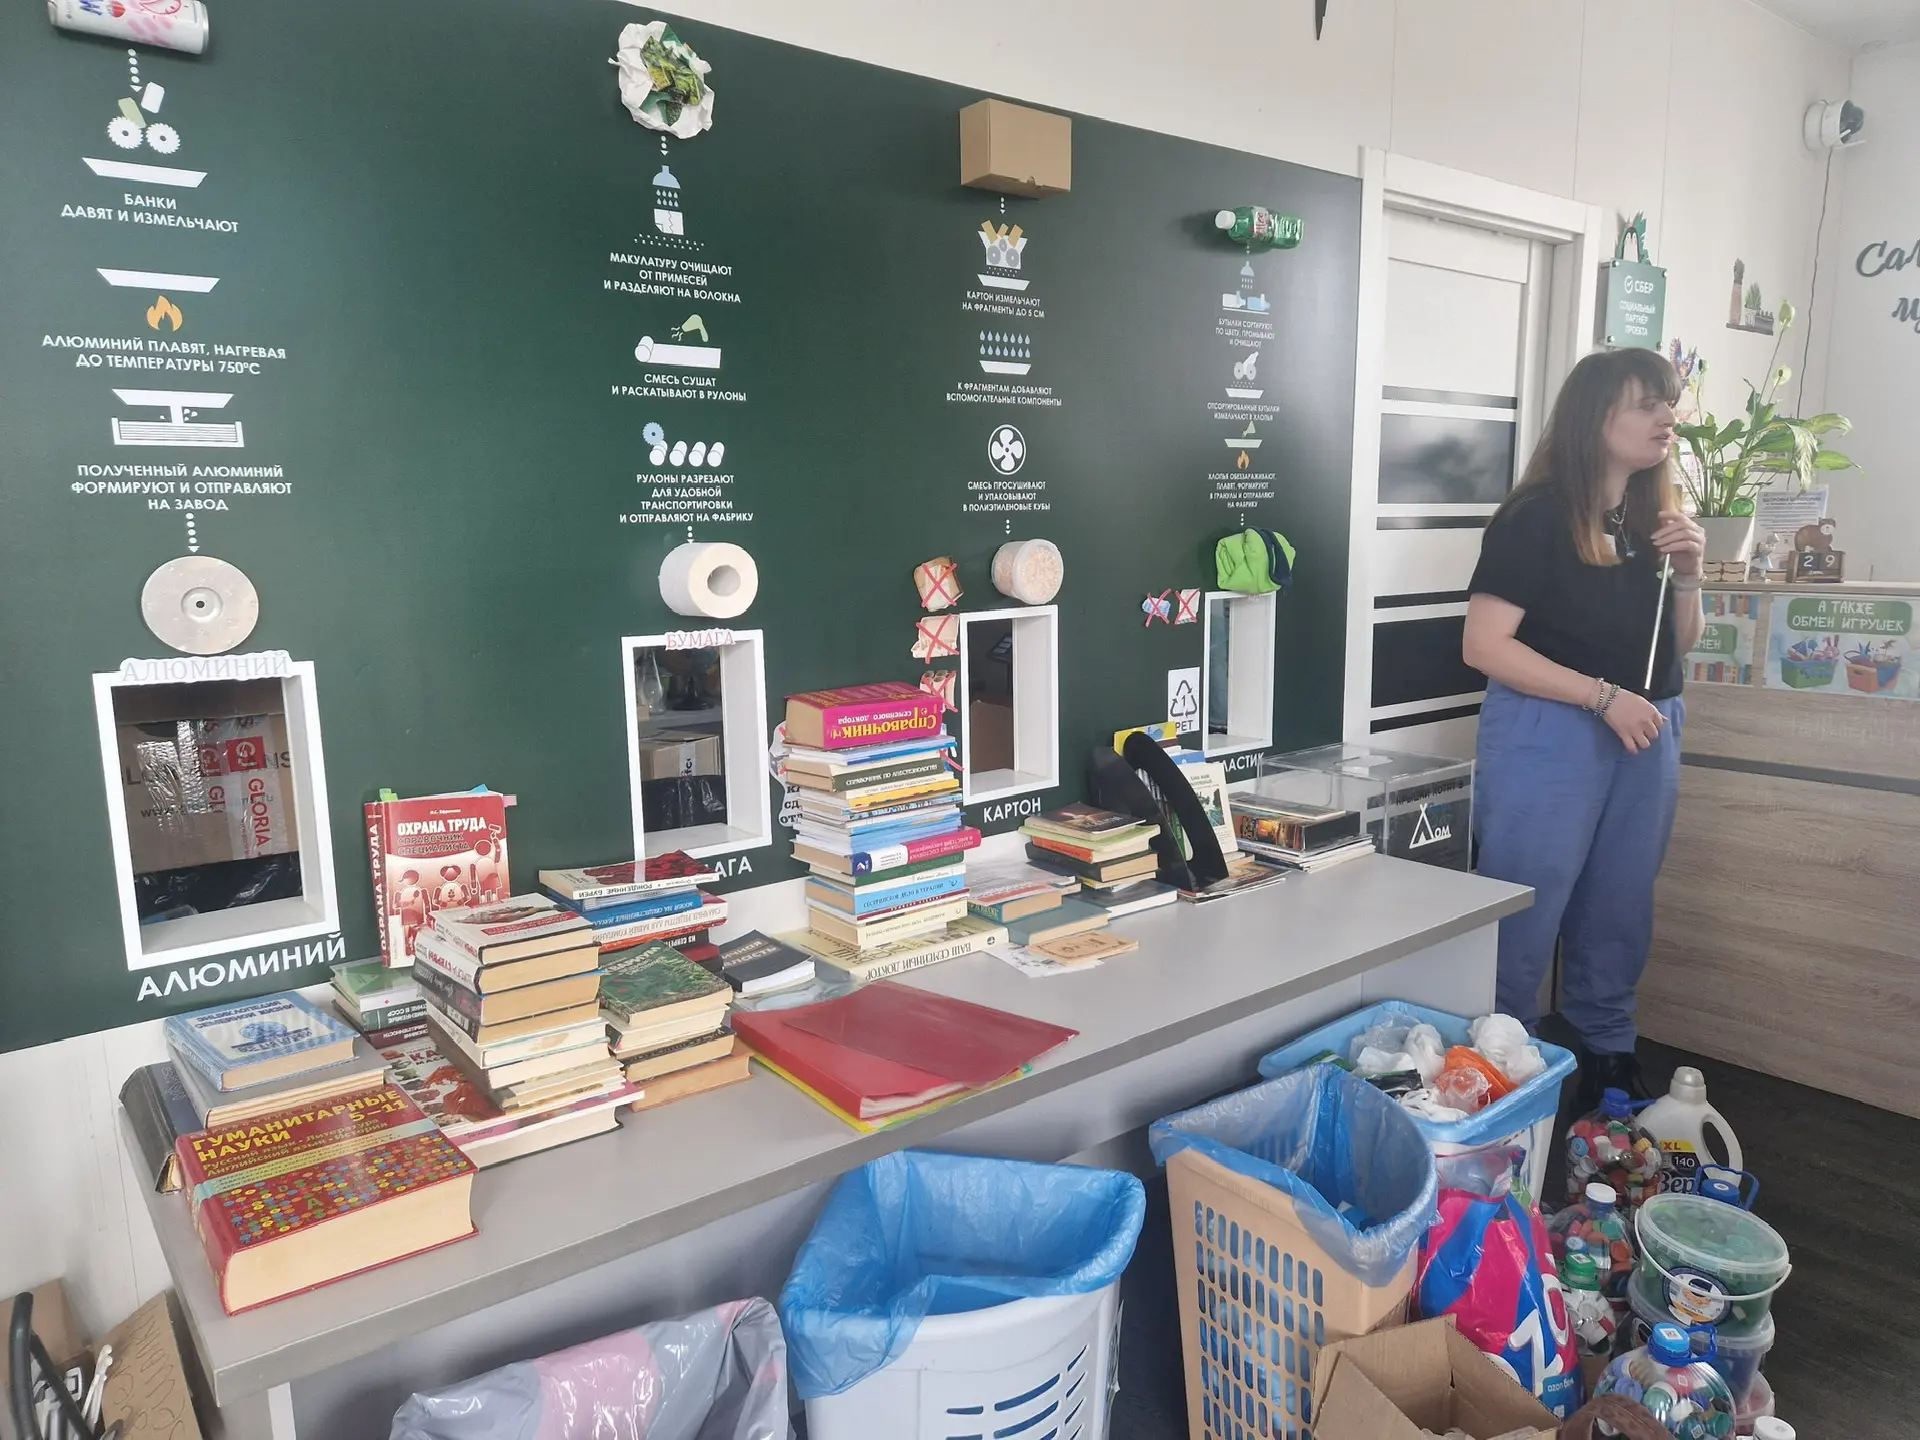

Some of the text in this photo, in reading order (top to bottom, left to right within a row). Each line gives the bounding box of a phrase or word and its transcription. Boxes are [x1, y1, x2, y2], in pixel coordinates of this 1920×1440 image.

[124, 193, 177, 209] БАНКИ
[61, 204, 239, 233] ДАВЯТ И ИЗМЕЛЬЧАЮТ
[610, 252, 732, 276] МАКУЛАТУРУ ОЧИЩАЮТ
[639, 269, 708, 286] ОТ ПРИМЕСЕЙ
[603, 280, 741, 303] И РАЗДЕЛЯЮТ НА ВОЛОКНА
[1634, 280, 1654, 294] СБЕР
[966, 290, 1041, 307] КАРТОН ИЗМЕЛЬЧАЮТ
[962, 301, 1045, 319] НА ФРАГМЕНТЫ ДО 5 СМ
[1620, 300, 1656, 314] СОЦИАЛЬНЫЙ
[1219, 318, 1273, 330] БУТЫЛКИ СОРТИРУЮТ
[1625, 325, 1648, 336] ПРОЕКТА
[1242, 330, 1275, 340] ПРОМЫВАЮТ
[42, 335, 286, 359] АЛЮМИНИЙ ПЛАВЯТ, НАГРЕВАЯ
[1235, 339, 1262, 348] ОЧИЩАЮТ
[76, 354, 102, 367] ДО
[107, 355, 213, 372] ТЕМПЕРАТУРЫ
[644, 373, 716, 387] СМЕСЬ СУШАТ
[611, 385, 747, 402] И РАСКАТЫВАЮТ В РУЛОНЫ
[957, 382, 1052, 395] К ФРАГМЕНТАМ ДОБАВЛЯЮТ
[946, 393, 1062, 406] ВСПОМОГАТЕЛЬНЫЕ КОМПОНЕНТЫ
[1207, 402, 1257, 411] ОТСОРТИРОВАННЫЕ
[77, 463, 283, 478] ПОЛУЧЕННЫЙ АЛЮМИНИЙ
[636, 473, 735, 484] РУЛОНЫ РАЗРЕЗАЮТ
[967, 481, 1046, 490] СМЕСЬ ПРОСУШИВАЮТ
[71, 481, 292, 495] ФОРМИРУЮТ И ОТПРАВЛЯЮТ
[651, 485, 722, 498] ДЛЯ УДОБНОЙ
[1238, 482, 1269, 490] ФОРМИРУЮТ
[978, 493, 1037, 501] И УПАКОВЫВАЮТ
[148, 499, 229, 511] НА ЗАВОД
[640, 500, 733, 510] ТРАНСПОРТИРОВКИ
[969, 503, 1032, 511] ПОЛИЭТИЛЕНОВЫЕ
[1033, 503, 1051, 511] КУБЫ
[619, 512, 754, 523] И ОТПРАВЛЯЮТ НА ФАБРИКУ
[1818, 601, 1875, 615] А ТАКЖЕ
[1792, 615, 1904, 632] ОБМЕН ИГРУШЕК
[666, 631, 735, 650] БУМАГА
[121, 650, 289, 683] АЛЮМИНИЙ
[842, 708, 937, 740] Справочник
[1175, 719, 1193, 733] PET
[846, 774, 882, 786] СПРАВОЧНИК
[883, 771, 891, 780] ПО
[248, 778, 272, 847] GLORIA
[983, 797, 1042, 824] КАРТОН
[397, 817, 487, 836] ОХРАНА ТРУДА
[398, 833, 464, 846] СПРАВОЧНИК
[397, 842, 470, 856] СПЕЦИАЛИСТА
[369, 824, 389, 950] ОХРАНА ТРУДА
[578, 888, 603, 899] БУРЕЙ
[606, 883, 653, 896] РОЖДЕННЫЕ
[949, 942, 972, 957] ВАШ
[137, 932, 347, 1001] АЛЮМИНИЙ
[864, 960, 900, 980] ДОКТОР
[194, 1003, 296, 1029] СЕМЕЙНОЙ ЖИЗНИ
[197, 1000, 282, 1022] ЭНЦИКЛОПЕДИЯ
[387, 1009, 404, 1018] СССР
[193, 1089, 402, 1152] ГУМАНИТАРНЫЕ
[198, 1131, 292, 1163] НАУКИ
[1663, 1141, 1681, 1151] XL
[202, 1151, 258, 1171] Русский
[206, 1153, 289, 1176] Английский
[1674, 1156, 1695, 1168] 140
